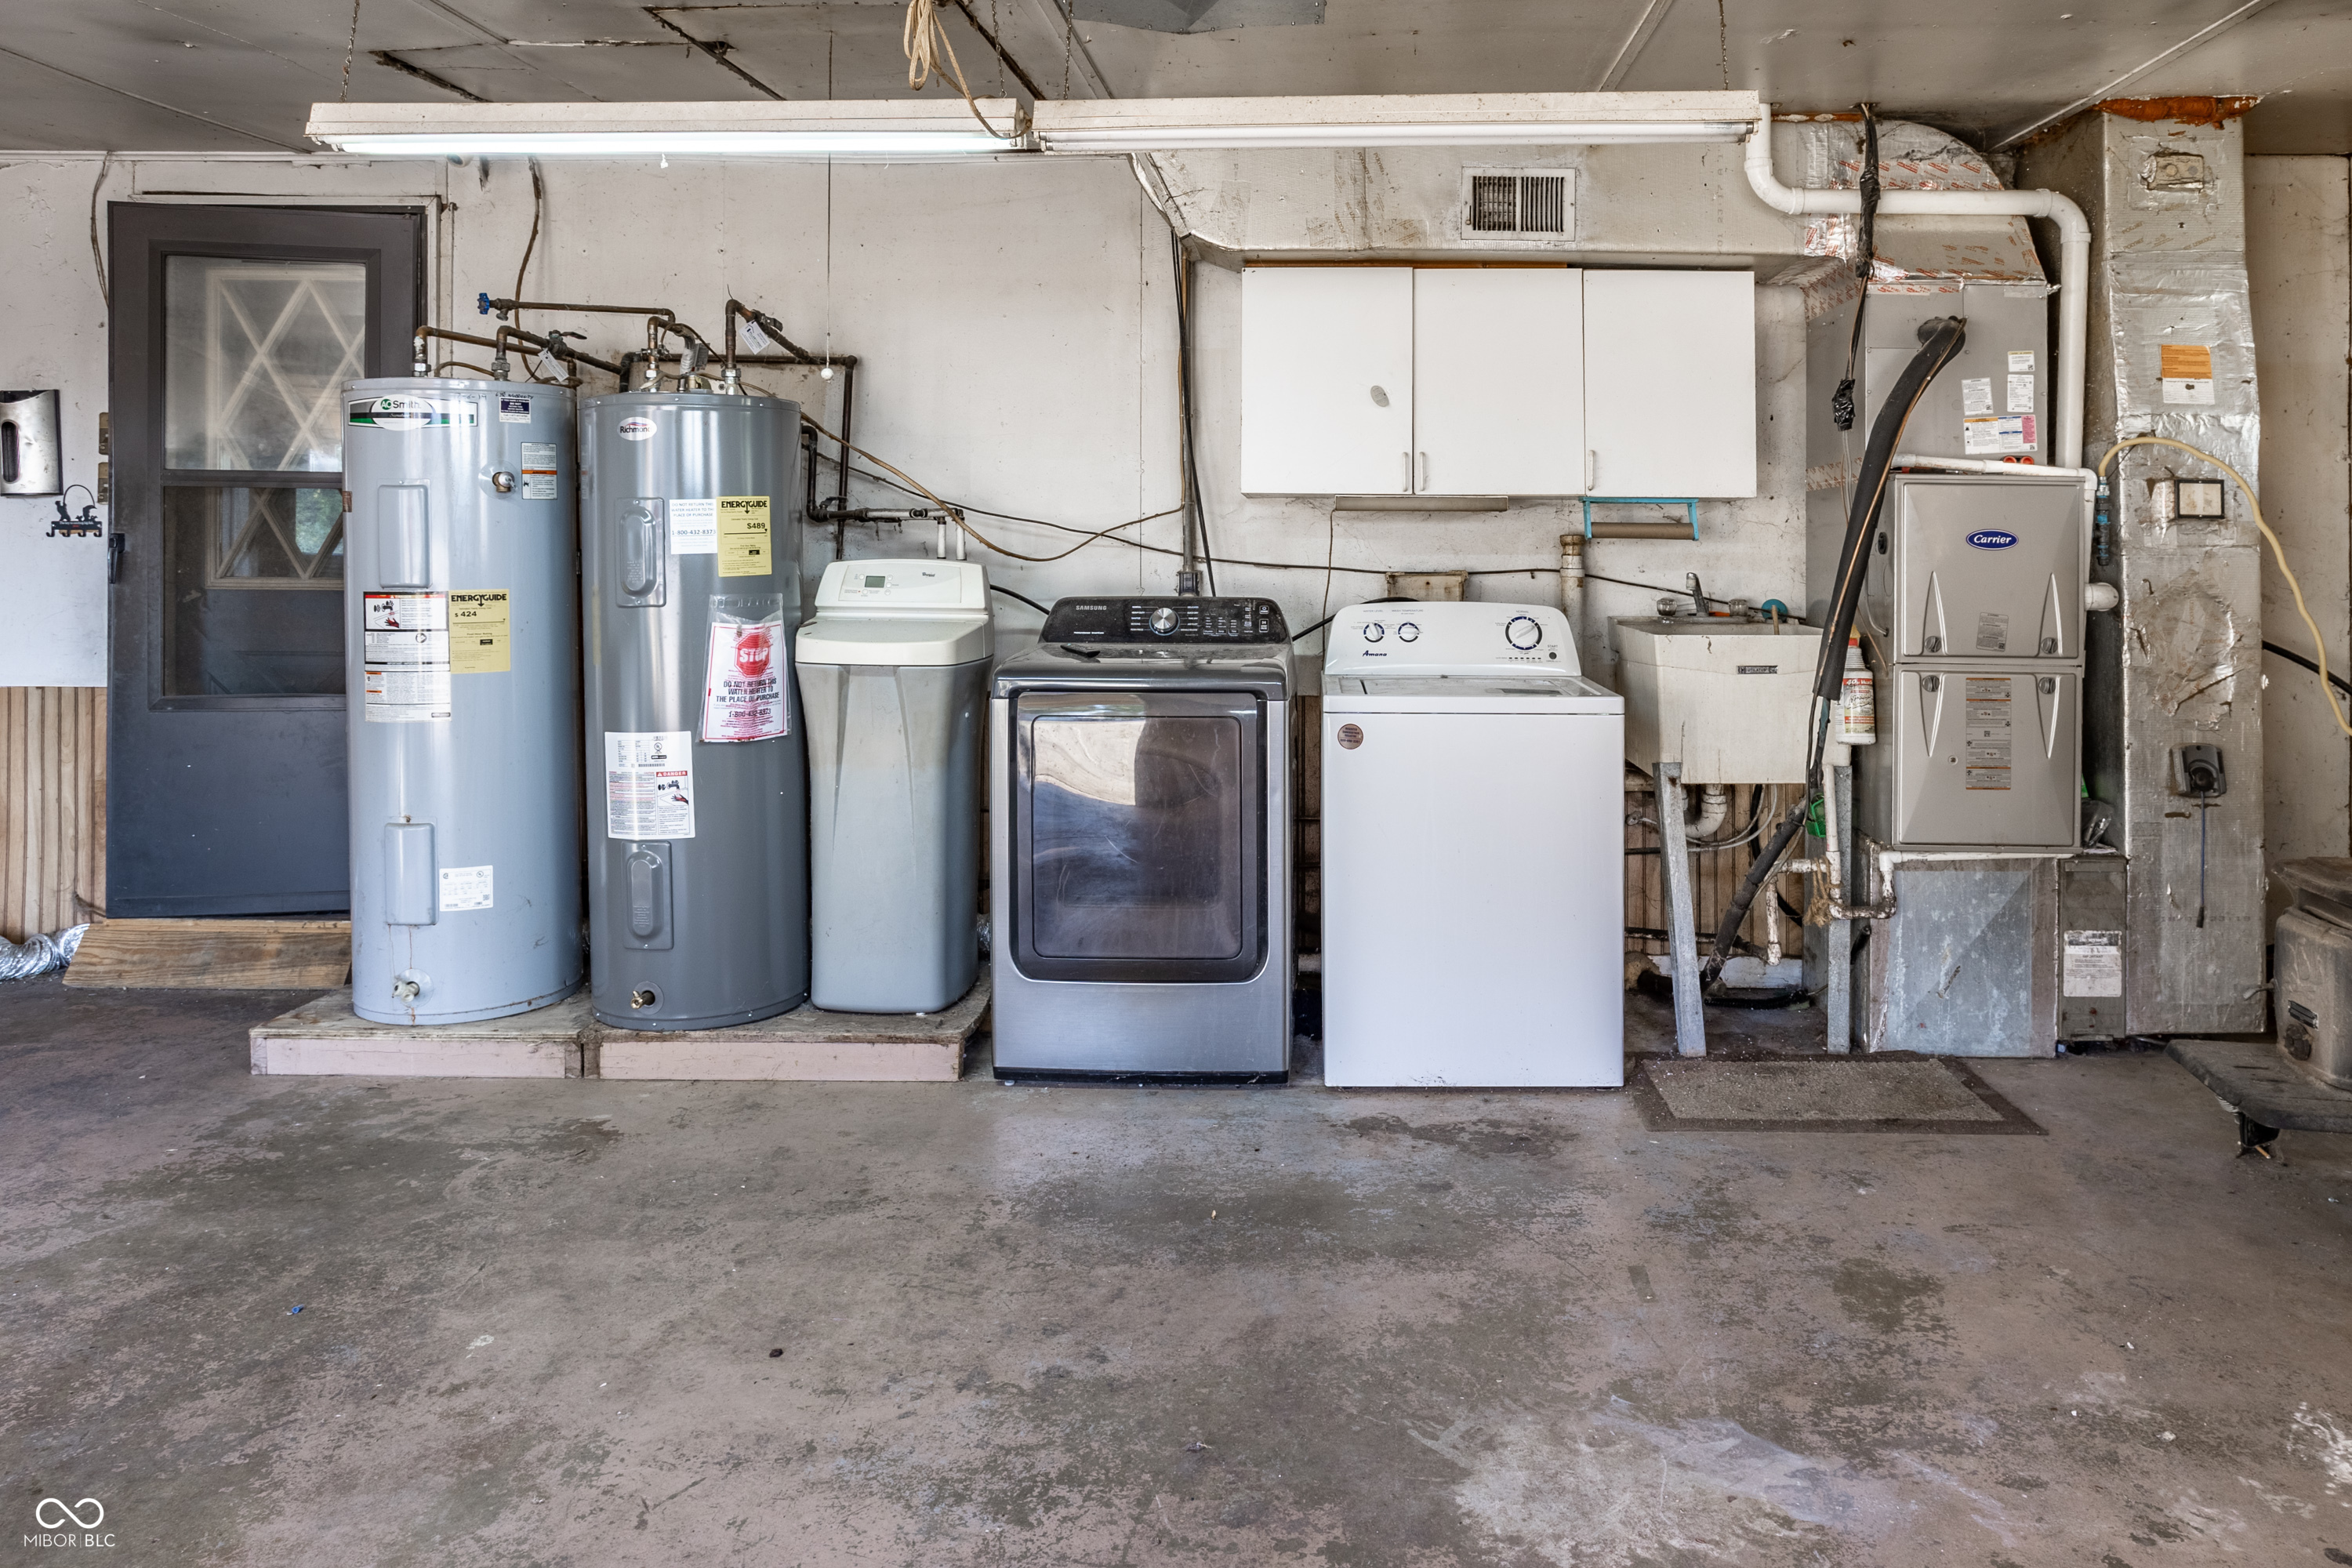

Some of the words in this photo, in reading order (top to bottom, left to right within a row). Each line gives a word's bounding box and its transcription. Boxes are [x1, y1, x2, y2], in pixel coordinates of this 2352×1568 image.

[720, 500, 768, 509] ENERGYGUIDE
[1973, 534, 2012, 543] Carrier
[451, 593, 507, 602] ENERGYGUIDE
[739, 648, 768, 662] STOP
[756, 691, 779, 702] PURCHASE
